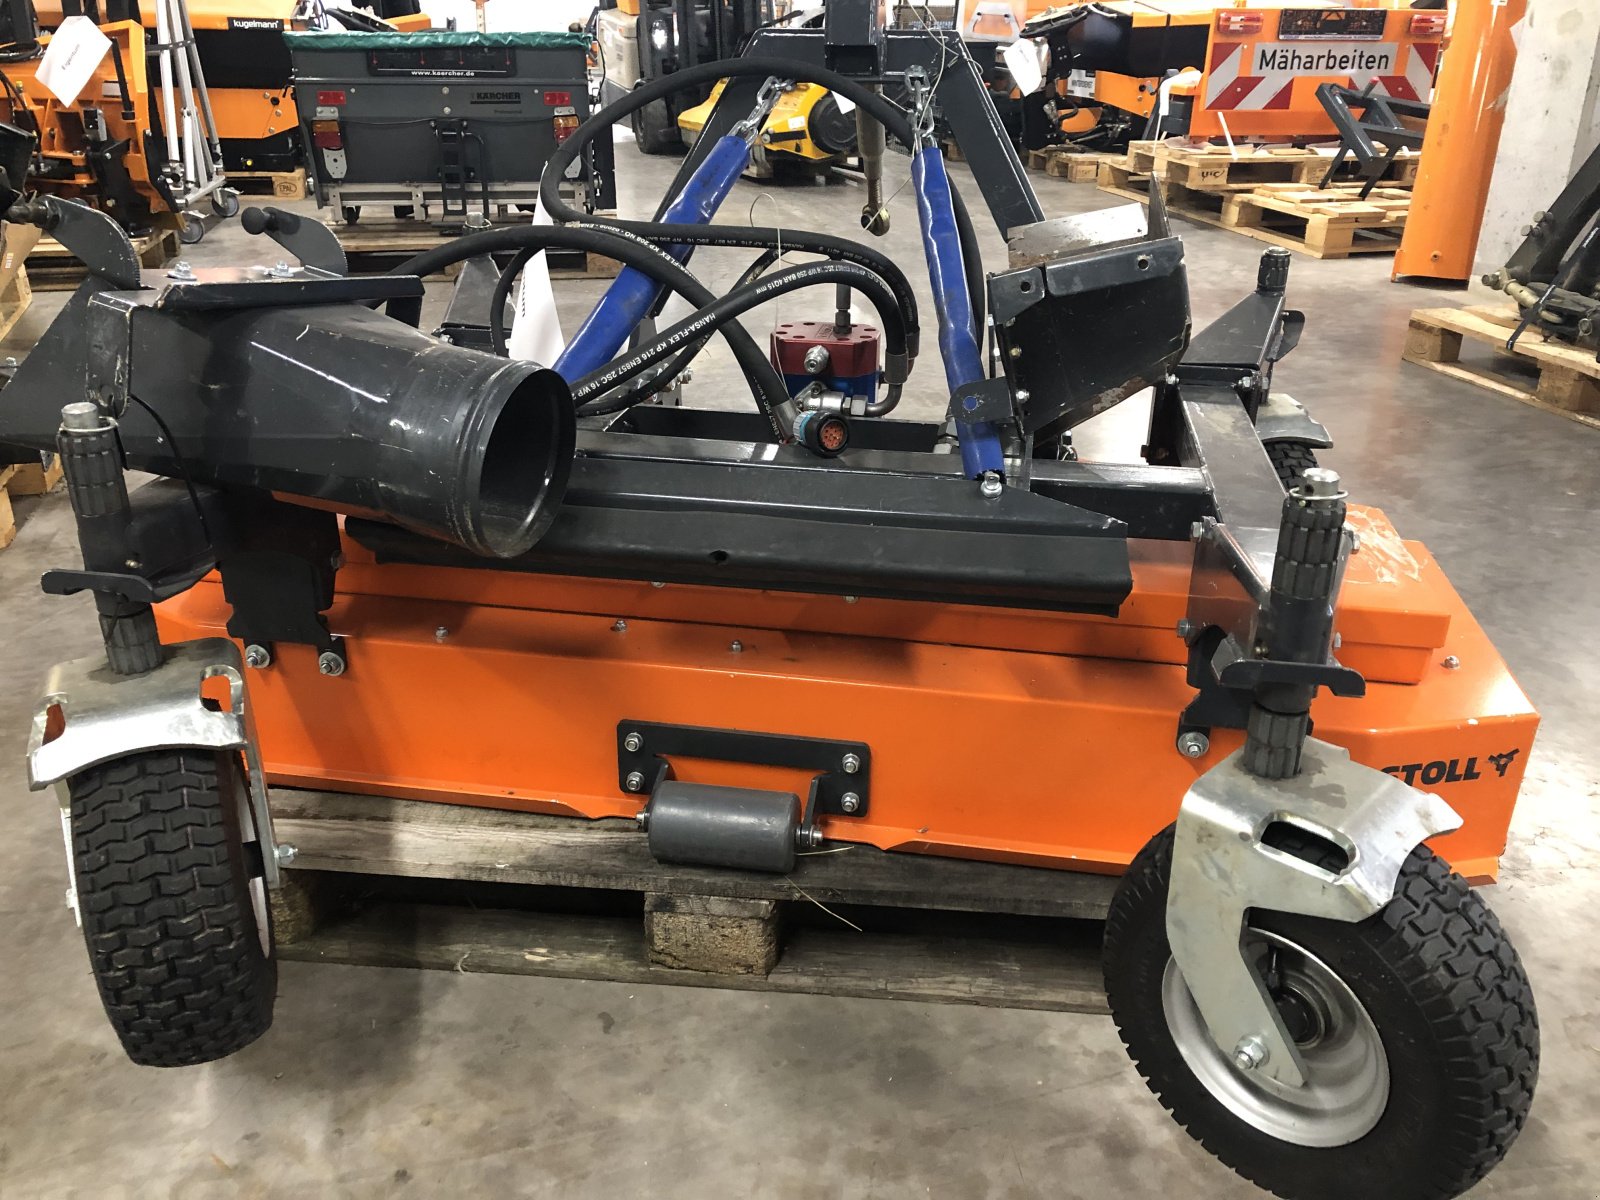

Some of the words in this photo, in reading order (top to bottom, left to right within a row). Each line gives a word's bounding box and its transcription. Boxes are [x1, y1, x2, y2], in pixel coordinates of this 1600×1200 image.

[233, 20, 278, 29] kugelmann
[1259, 49, 1389, 70] Mäharbeiten
[783, 273, 797, 283] BAR
[767, 279, 784, 291] 4Q15
[671, 313, 716, 345] HANSA-FLEX
[641, 348, 656, 360] 216
[656, 343, 668, 353] KP
[618, 356, 642, 371] EN857
[602, 371, 618, 384] 2SC
[590, 381, 600, 390] 16
[577, 387, 590, 400] WP
